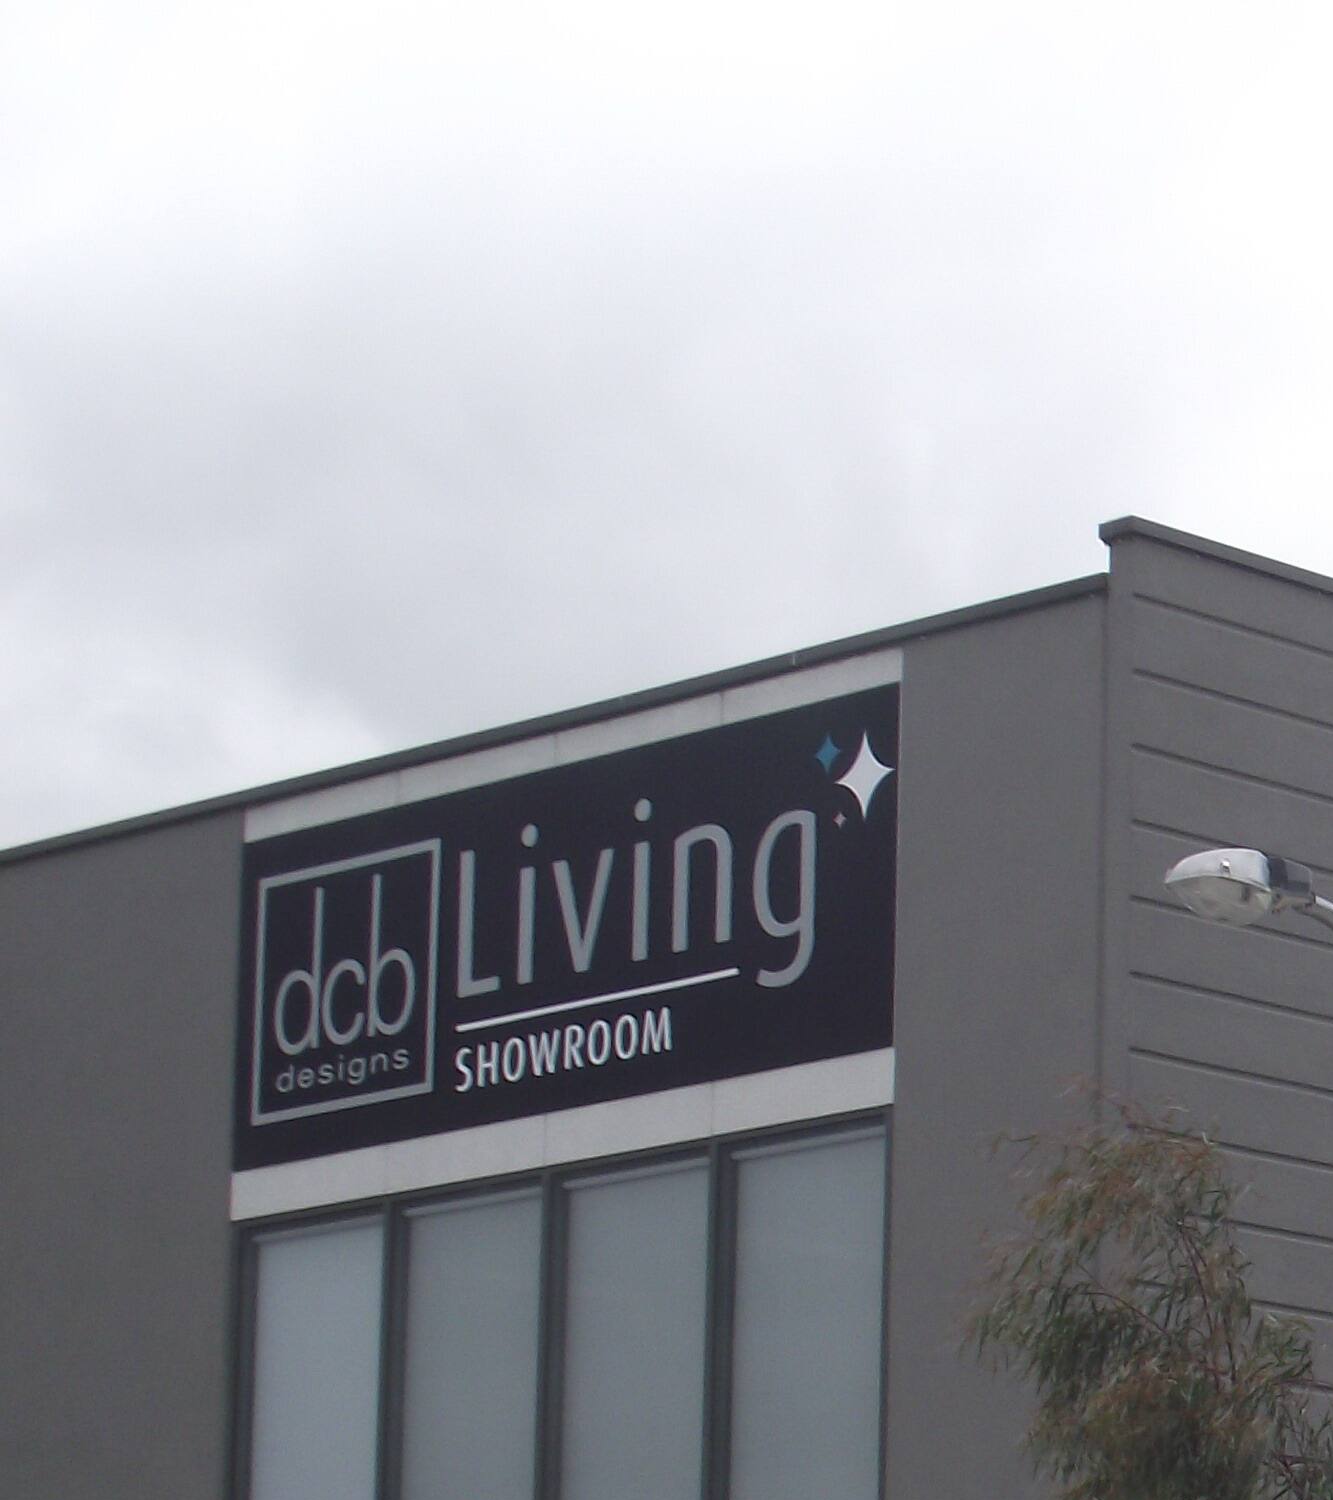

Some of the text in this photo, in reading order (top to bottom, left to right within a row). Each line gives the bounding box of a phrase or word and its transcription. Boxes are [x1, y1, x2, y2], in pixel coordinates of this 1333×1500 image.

[274, 874, 416, 1056] dcb
[457, 798, 817, 999] Living
[276, 1046, 410, 1093] designs
[455, 1006, 673, 1092] SHOWROOM
